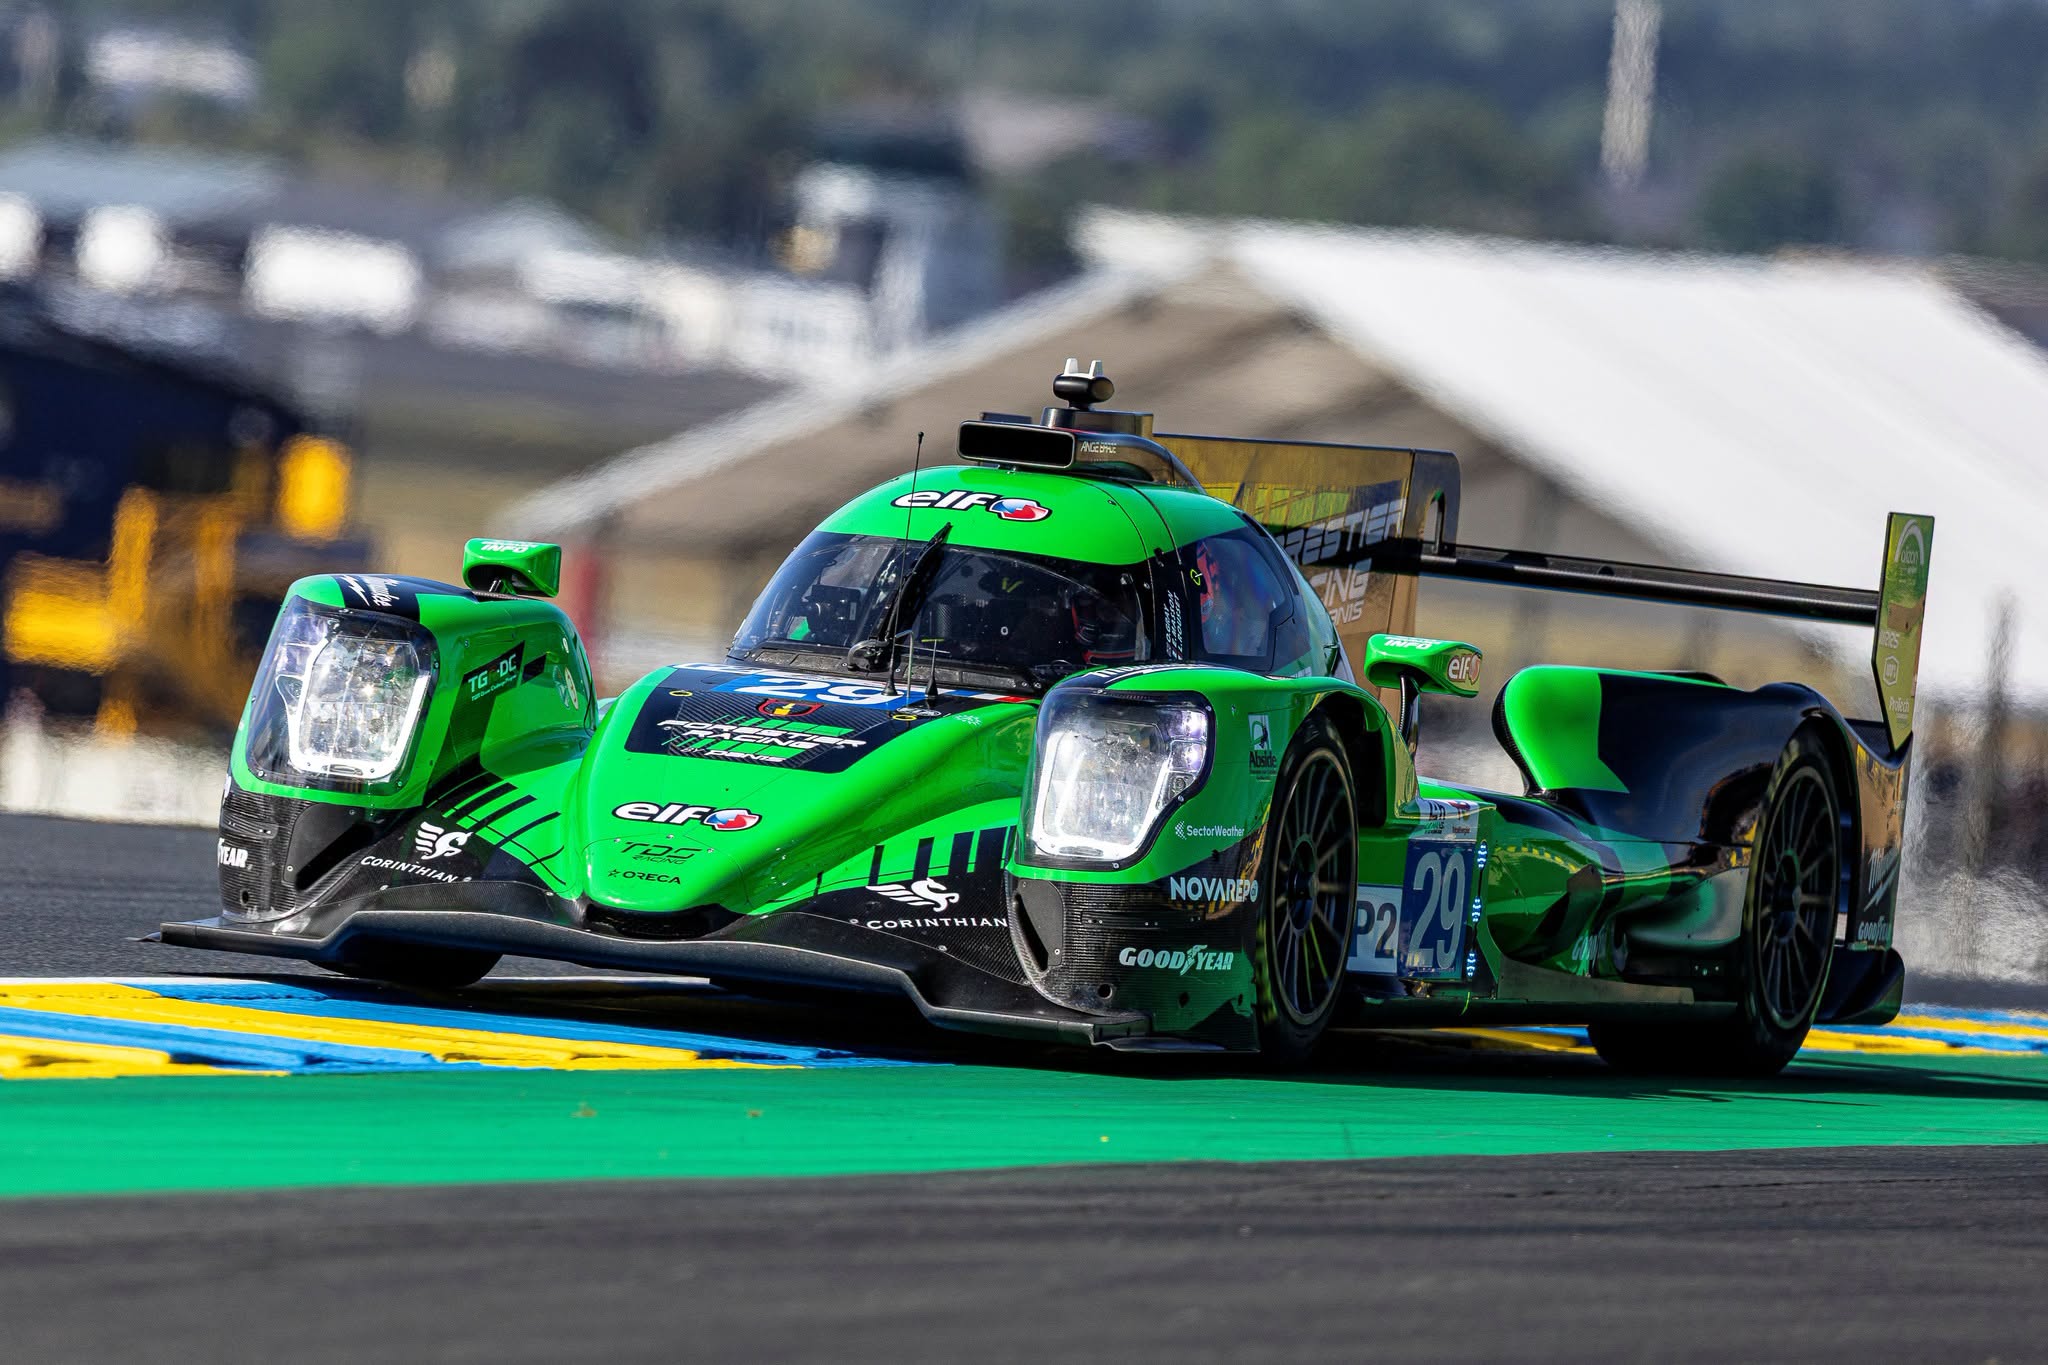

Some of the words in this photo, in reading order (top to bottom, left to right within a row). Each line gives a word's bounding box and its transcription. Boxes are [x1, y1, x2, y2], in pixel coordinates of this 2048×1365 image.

[893, 489, 998, 510] elf
[1275, 498, 1406, 566] RESTIER
[1447, 656, 1471, 680] elf
[733, 678, 905, 705] 29
[657, 719, 867, 748] FORESTIER
[682, 729, 820, 749] RACING
[1249, 750, 1277, 768] Abside
[614, 801, 713, 825] elf
[1186, 825, 1245, 837] SectorWeather
[621, 841, 702, 859] TDS
[632, 855, 687, 865] RACING
[360, 856, 459, 883] CORINTHIAN
[623, 870, 681, 884] ORECA
[1406, 851, 1466, 970] 29
[866, 917, 1009, 930] CORINTHIAN
[1349, 900, 1398, 959] P2
[1119, 945, 1234, 976] GOODYEAR
